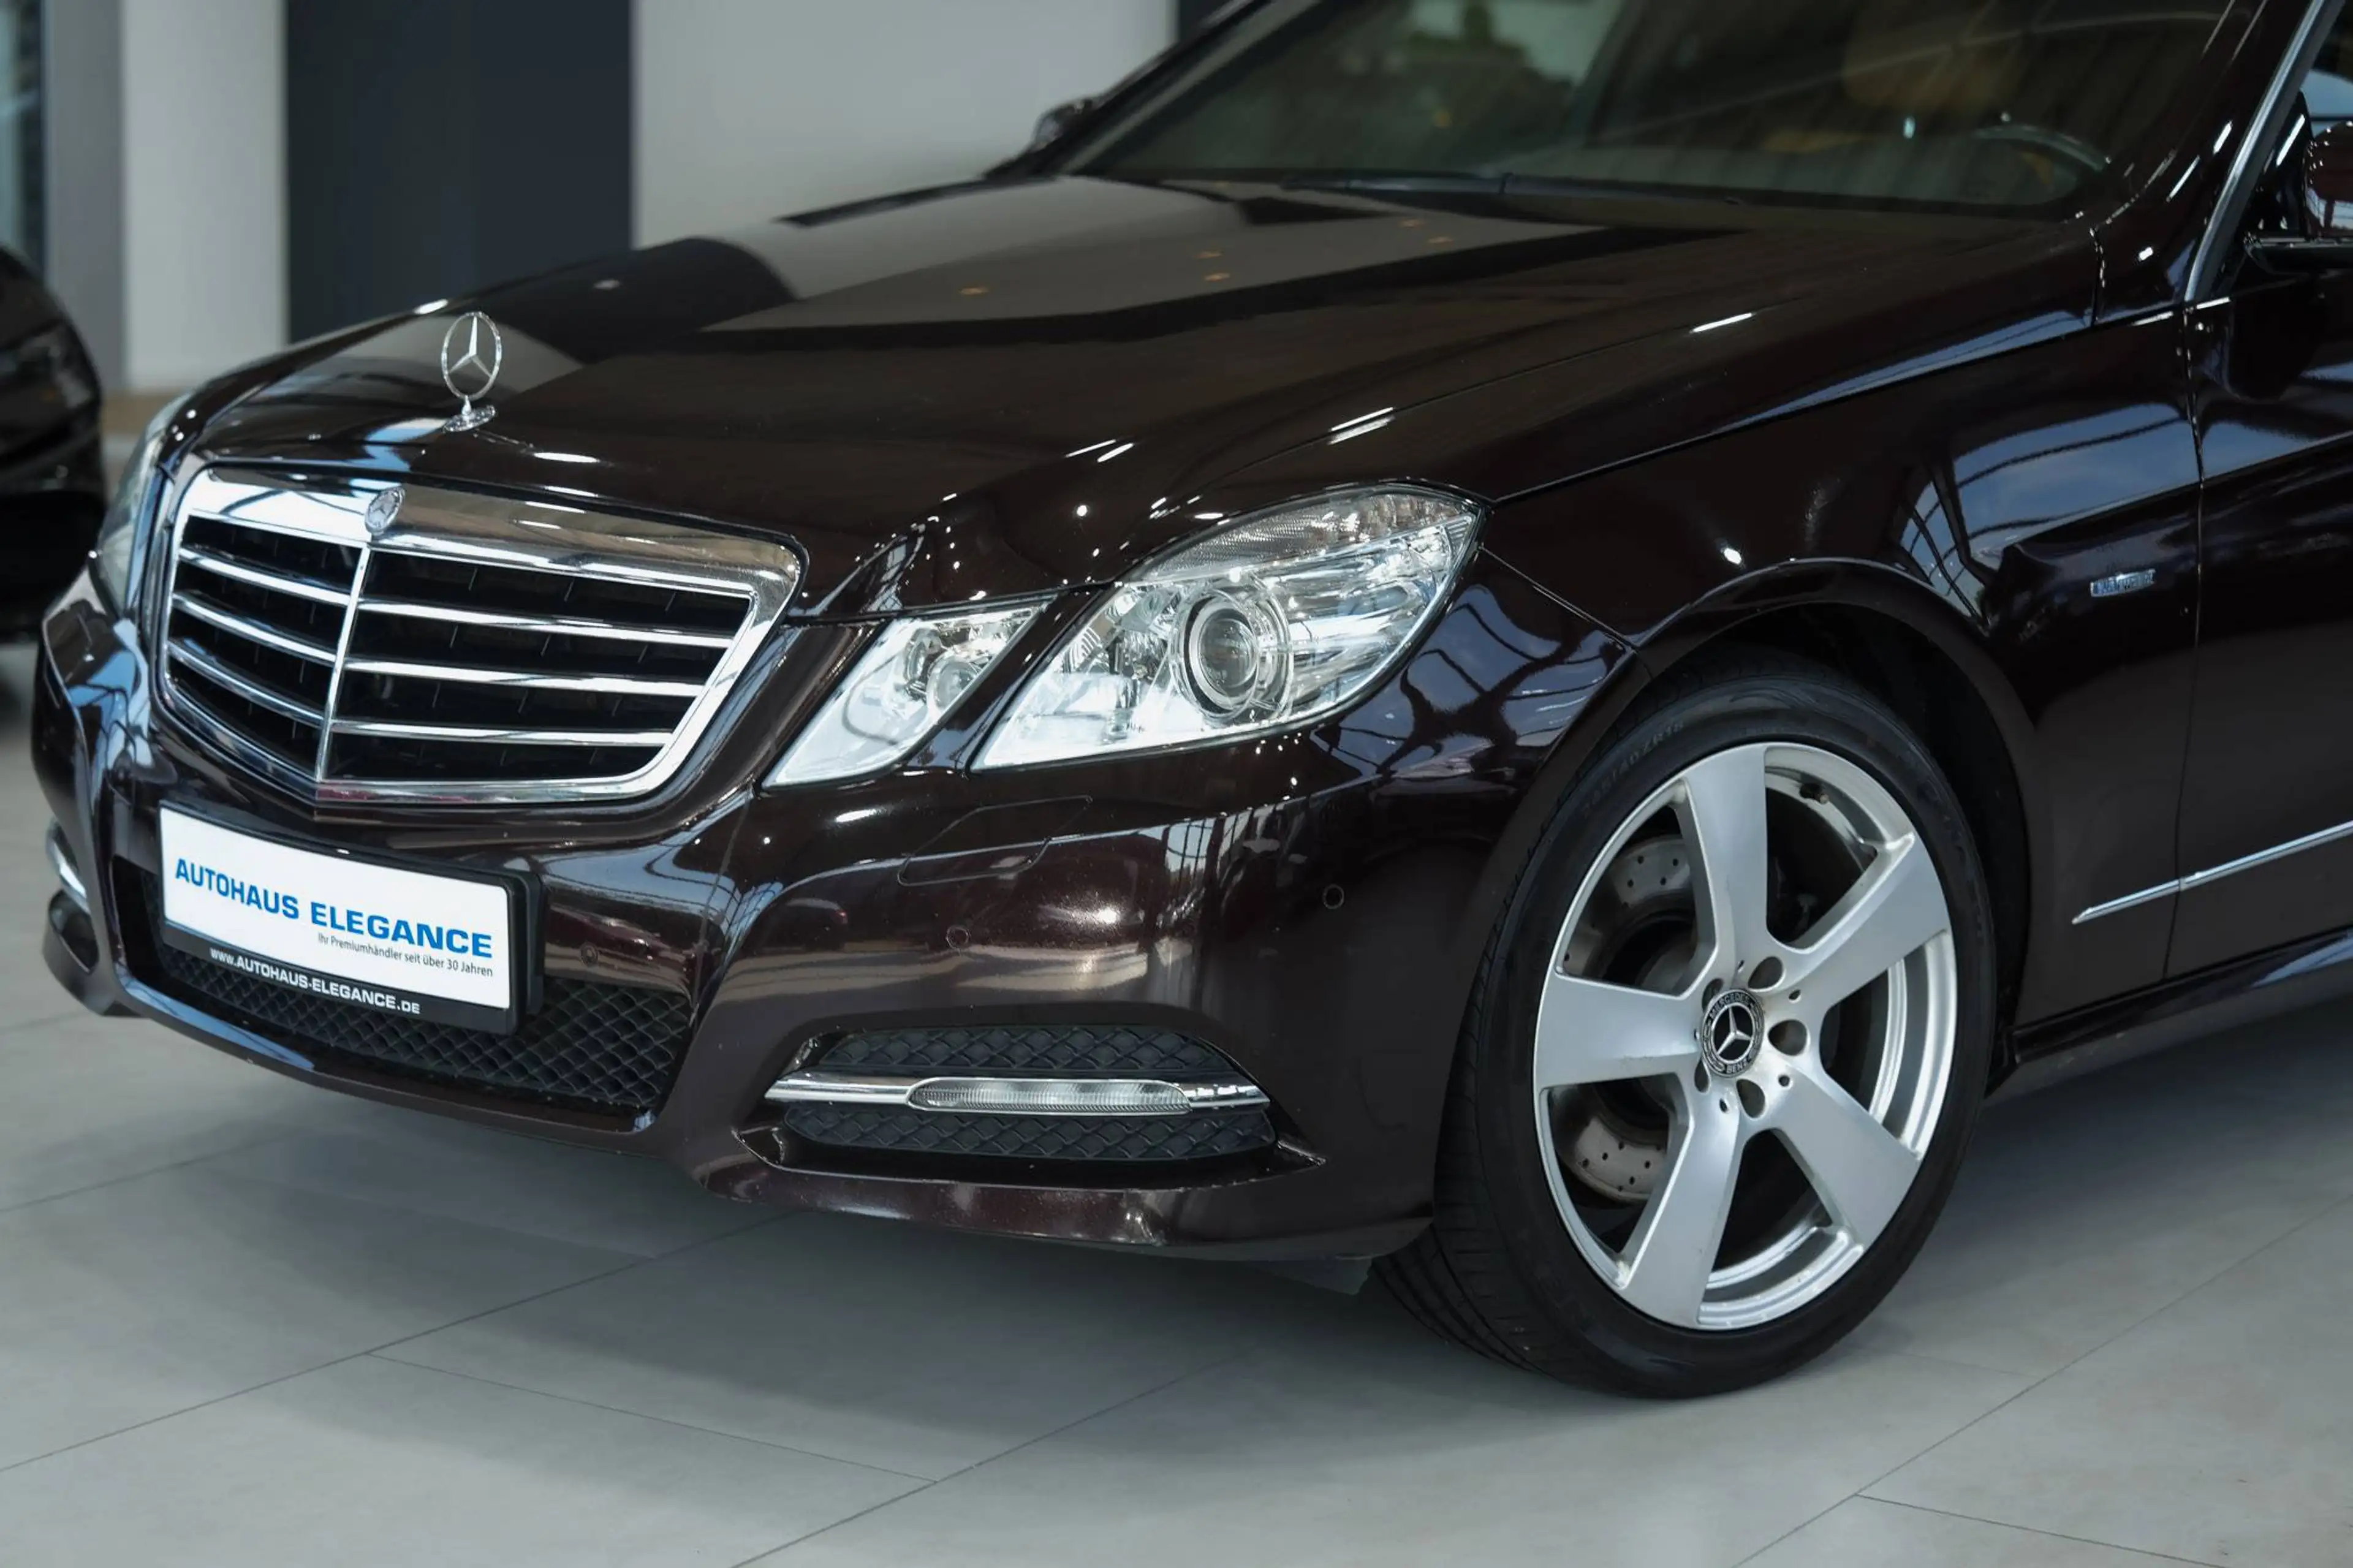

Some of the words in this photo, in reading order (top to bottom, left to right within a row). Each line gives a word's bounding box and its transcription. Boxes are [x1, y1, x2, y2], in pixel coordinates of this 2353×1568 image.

[175, 858, 299, 920] AUTOHAUS
[311, 901, 493, 958] ELEGANCE
[318, 933, 329, 945] Ihr
[331, 936, 402, 961] Premiumhändler
[404, 953, 421, 964] seit
[423, 955, 444, 969] über
[447, 958, 459, 971] 30
[461, 962, 493, 978] Jahren
